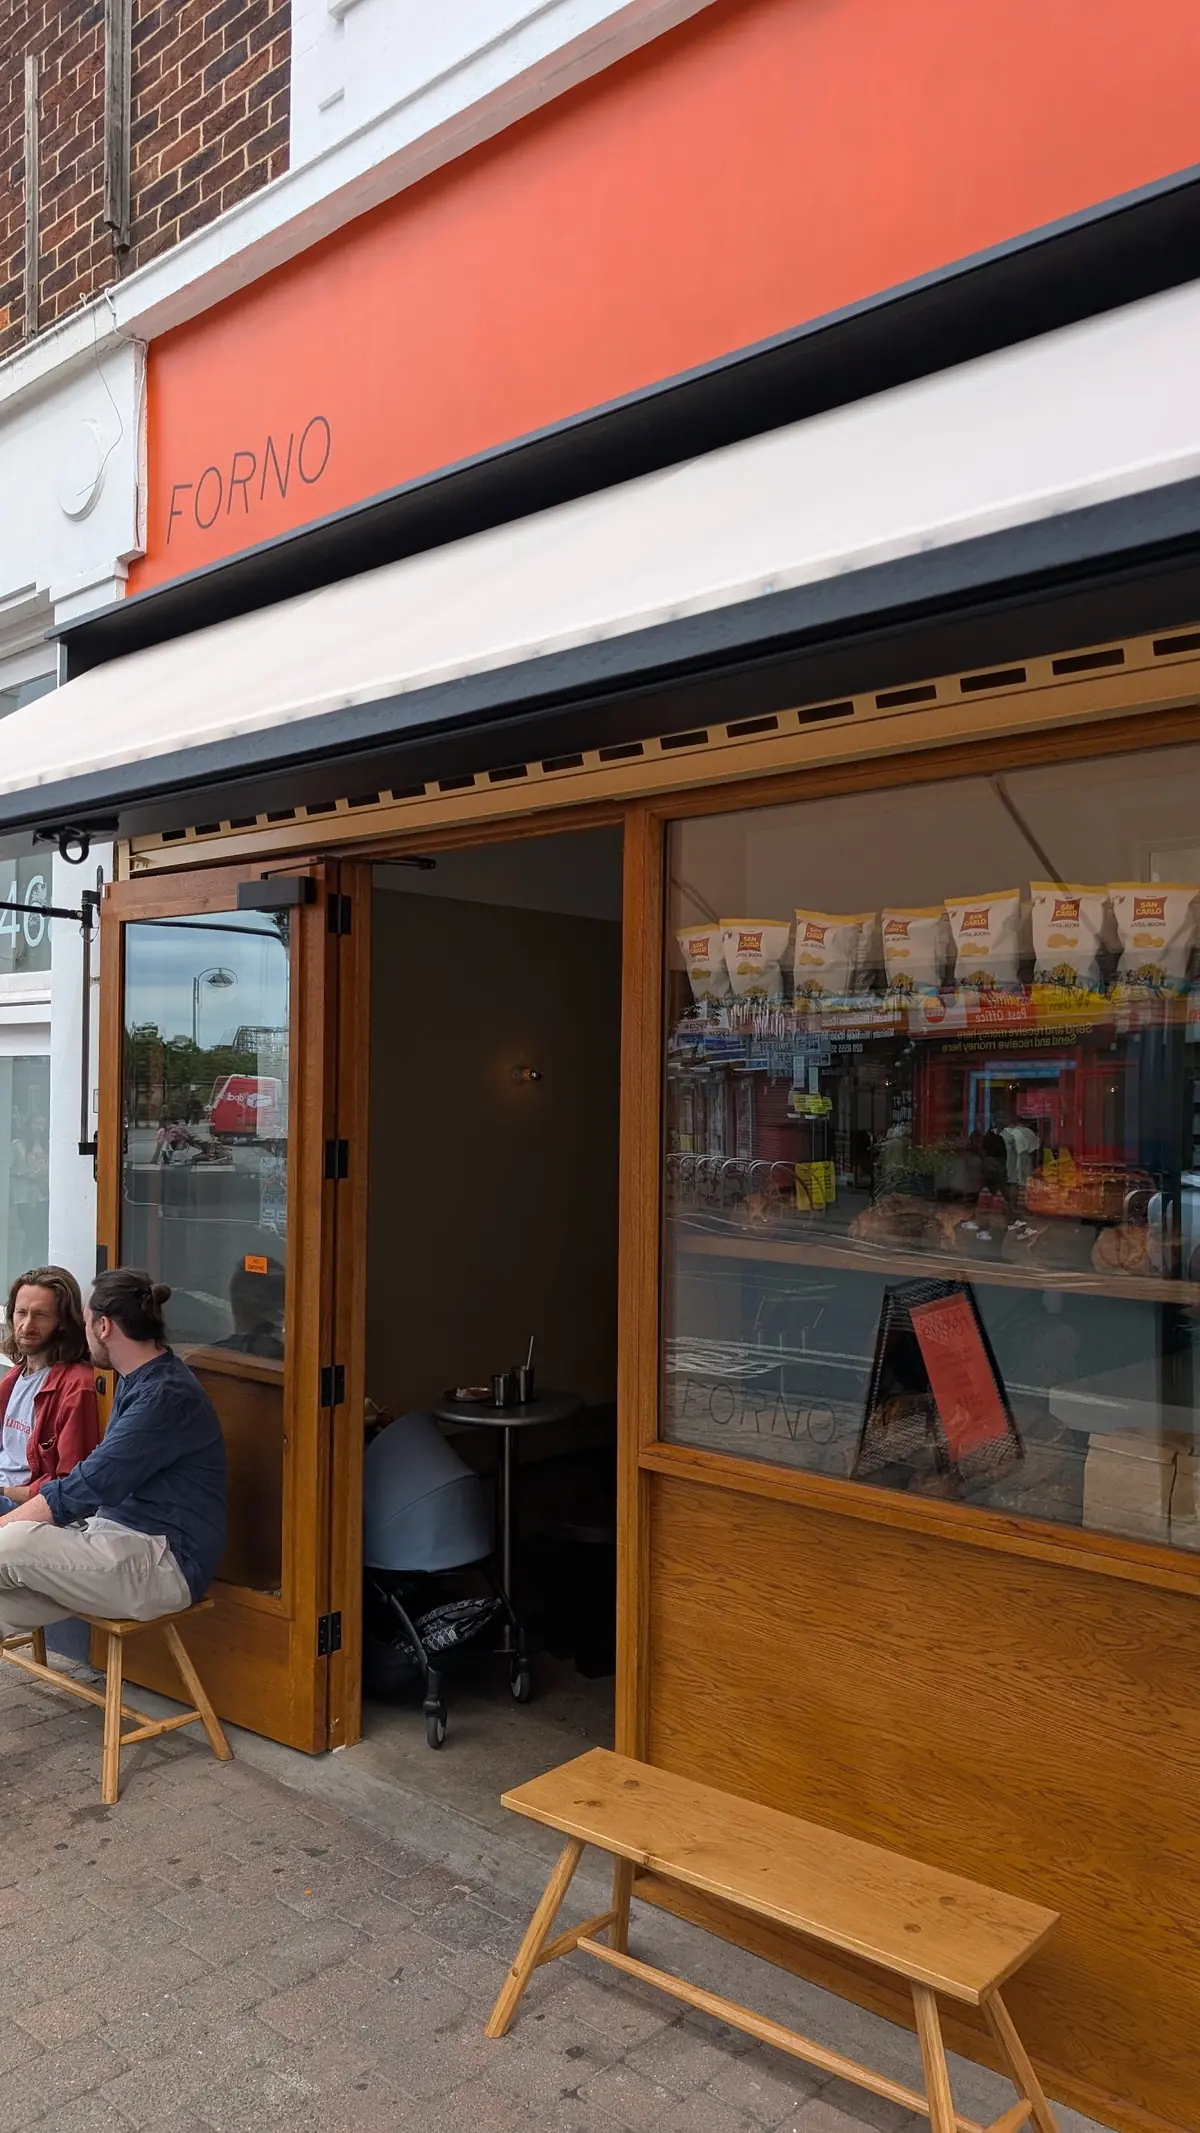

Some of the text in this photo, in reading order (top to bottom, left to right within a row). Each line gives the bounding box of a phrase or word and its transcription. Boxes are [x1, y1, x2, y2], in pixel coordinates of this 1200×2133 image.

[166, 415, 331, 545] FORNO
[1136, 908, 1162, 916] CARLO
[1140, 901, 1158, 909] SAN
[680, 1378, 837, 1446] FORNO
